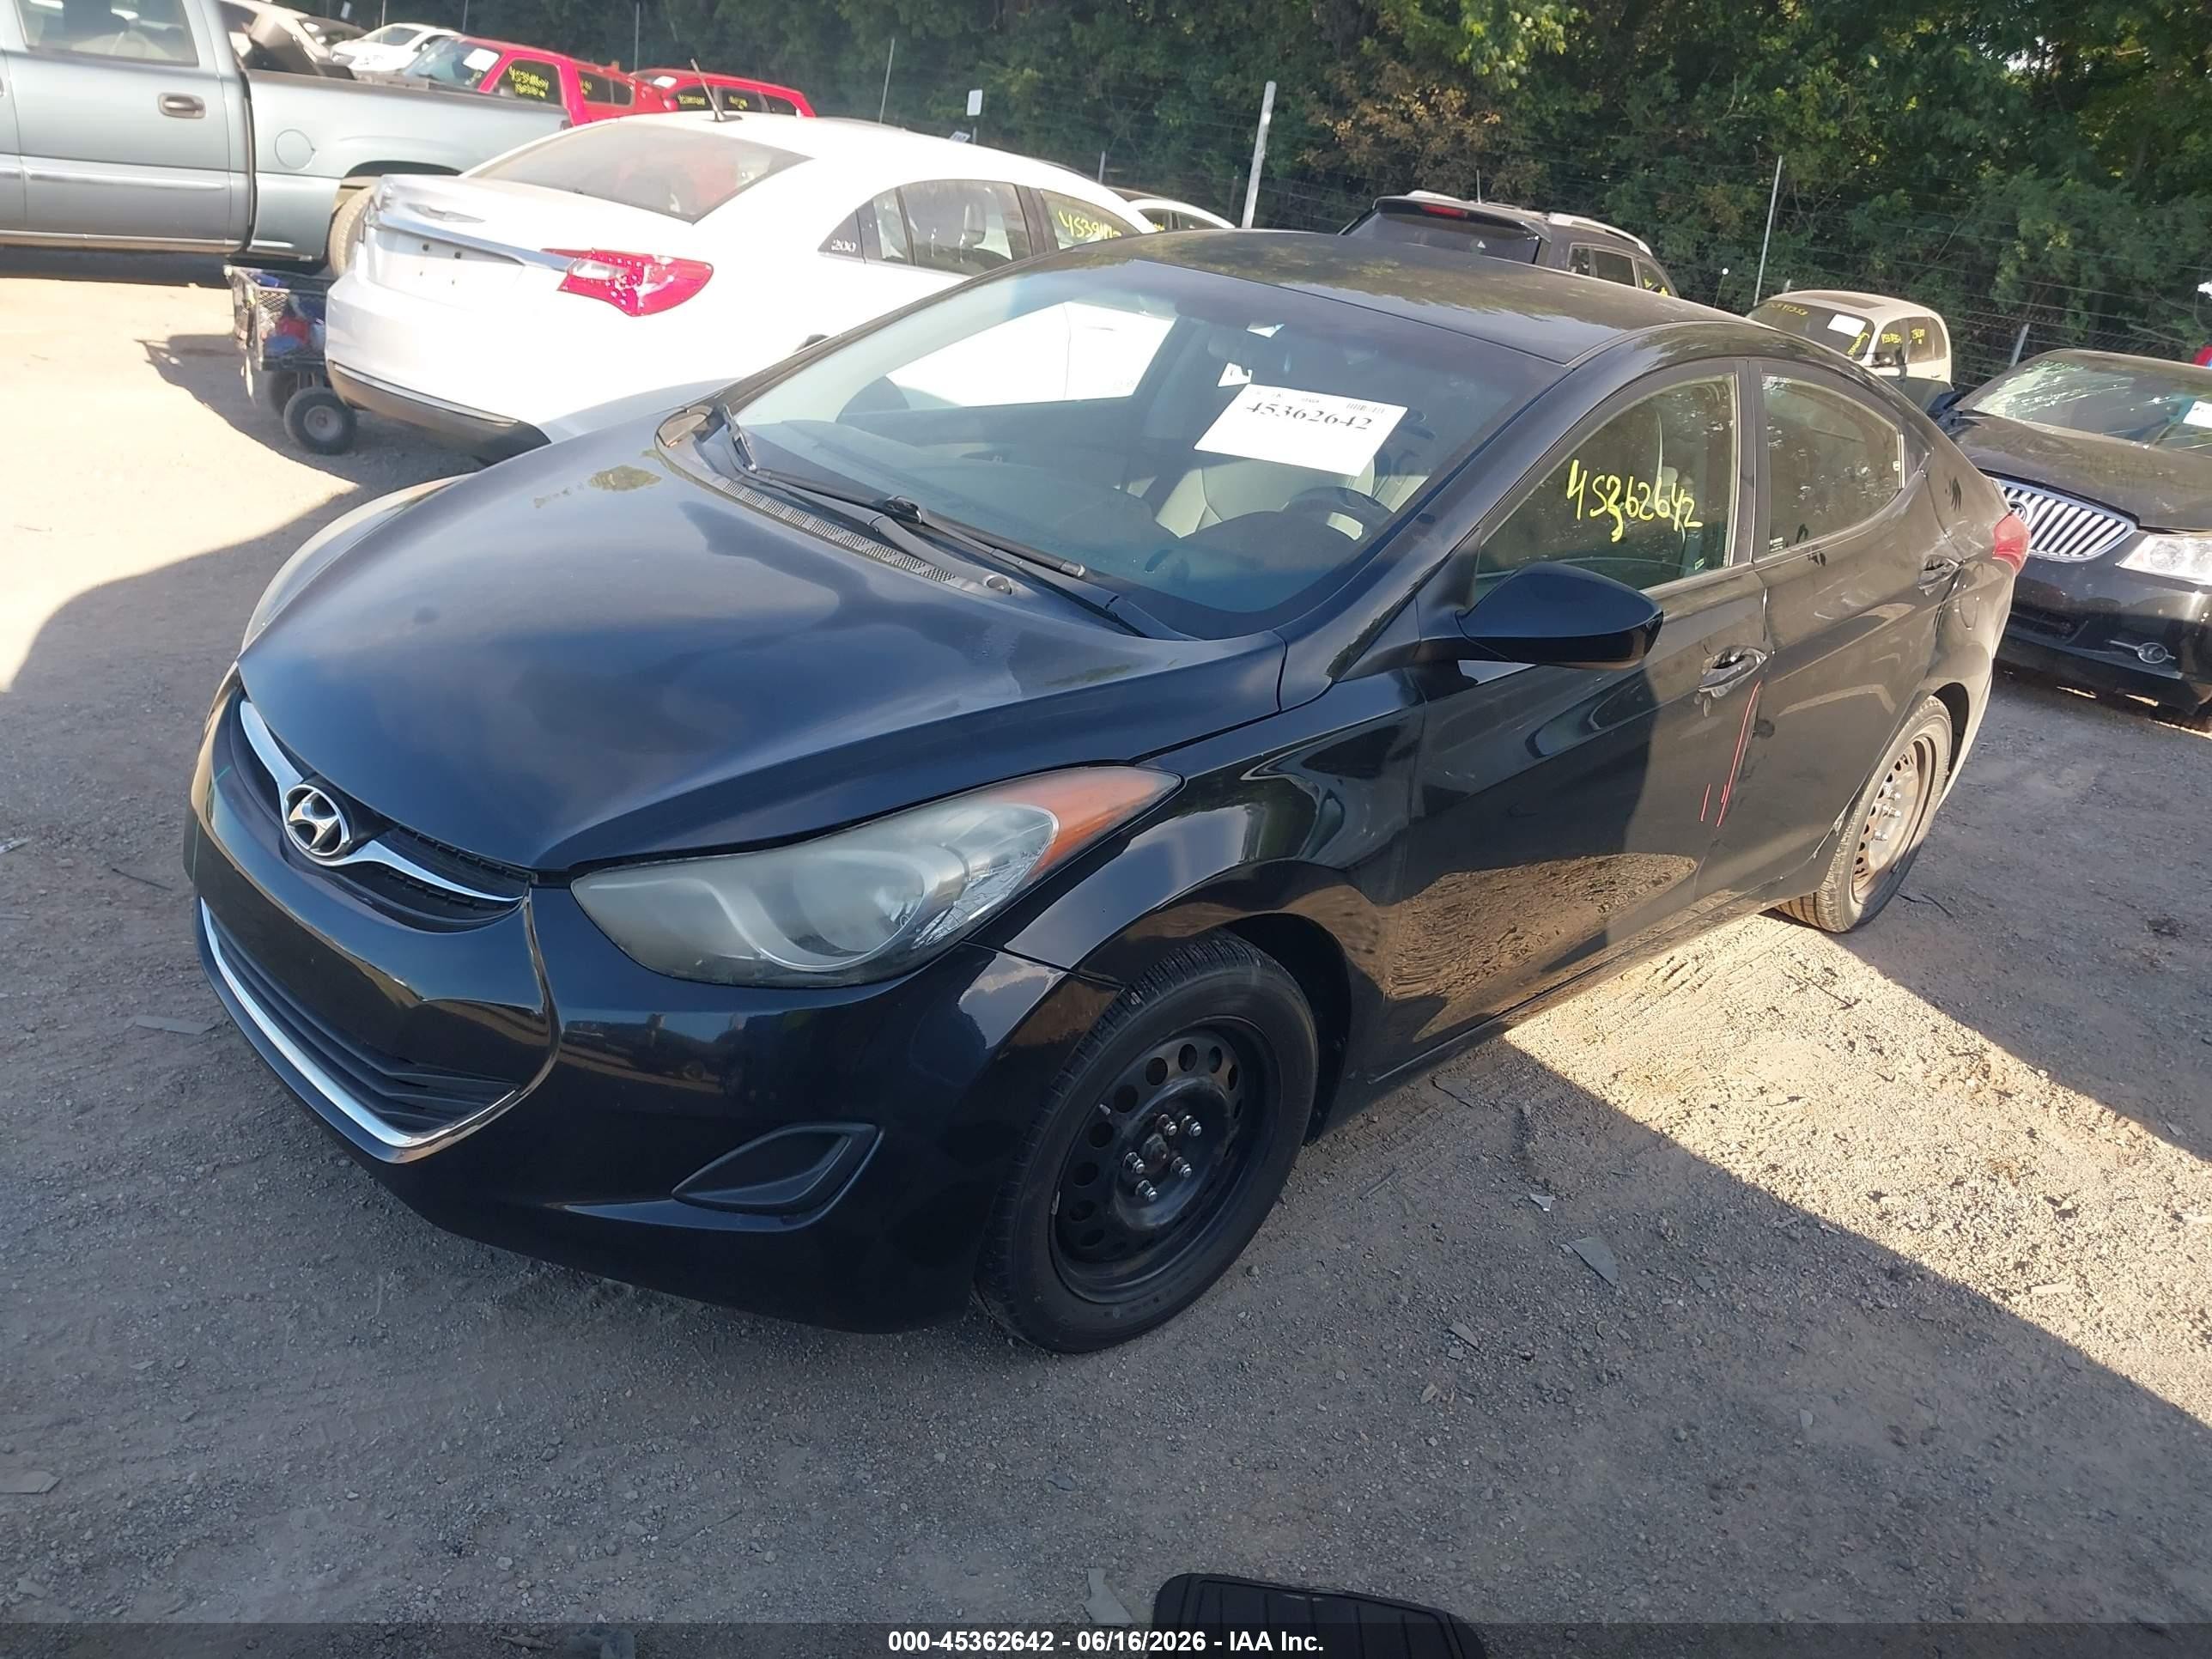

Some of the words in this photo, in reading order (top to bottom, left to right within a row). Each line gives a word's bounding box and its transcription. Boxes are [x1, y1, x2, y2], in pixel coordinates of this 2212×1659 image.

[830, 239, 857, 252] 200
[1246, 402, 1373, 430] 45362642
[1567, 459, 1704, 543] 45362642
